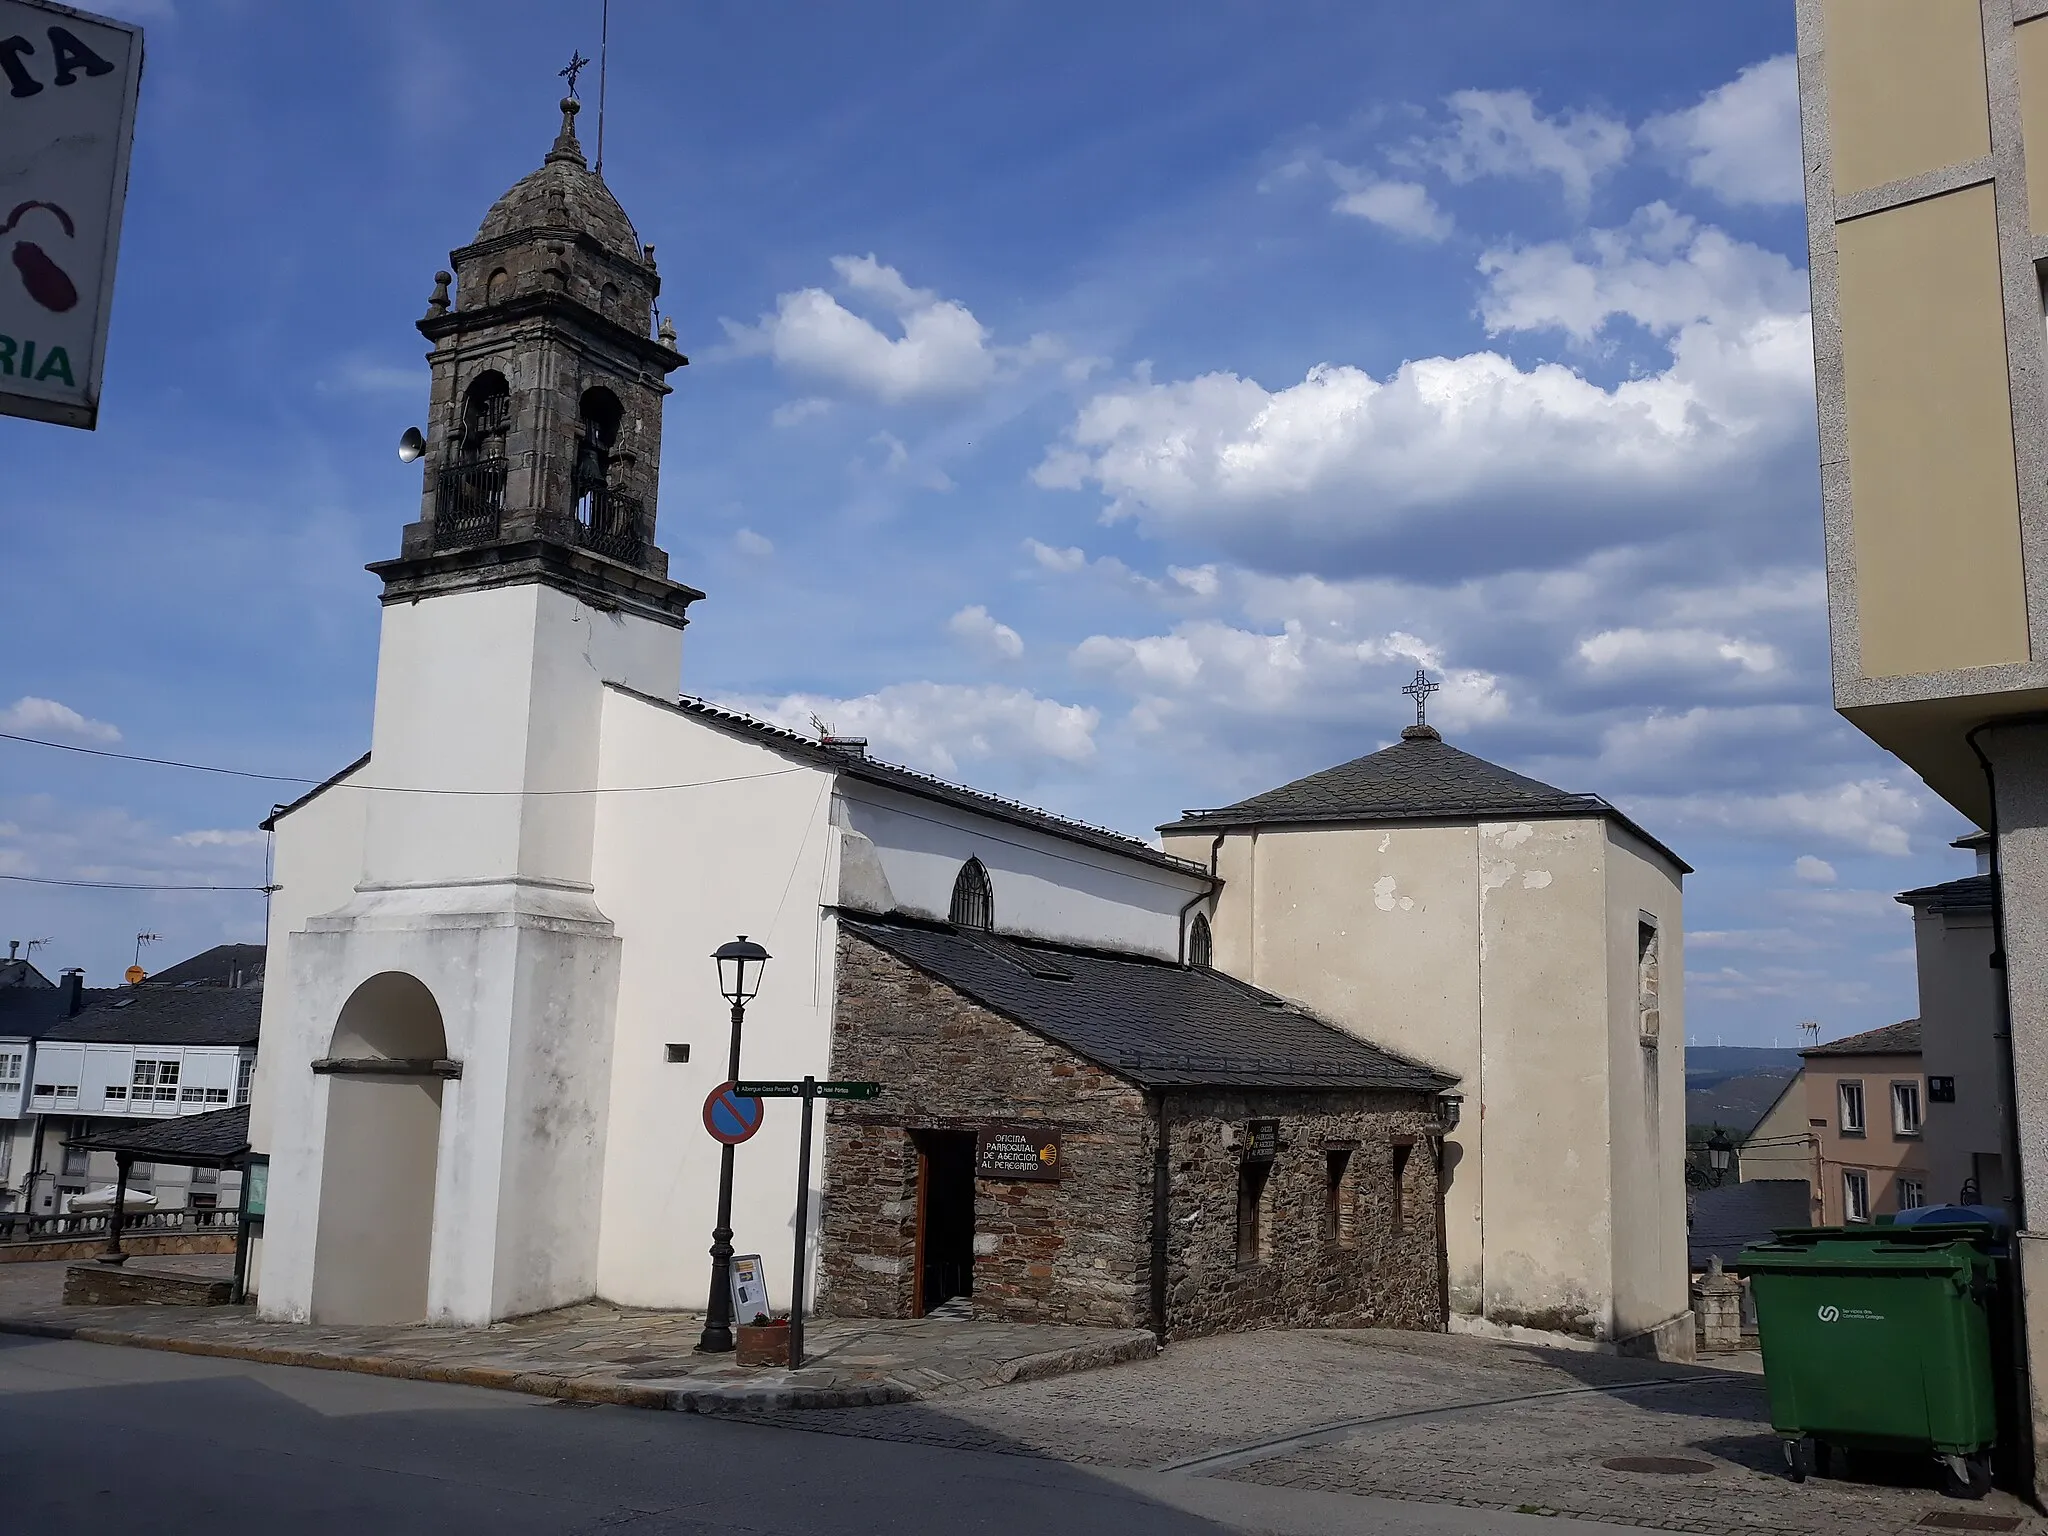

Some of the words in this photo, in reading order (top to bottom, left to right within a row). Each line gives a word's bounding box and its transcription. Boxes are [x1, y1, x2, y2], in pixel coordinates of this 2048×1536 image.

[741, 1085, 761, 1093] Albergue
[995, 1134, 1026, 1143] OFICINA
[986, 1143, 1035, 1152] PARROQUIAL
[983, 1152, 995, 1160] DE
[981, 1160, 991, 1169] AL
[994, 1161, 1039, 1171] PEREGRINO
